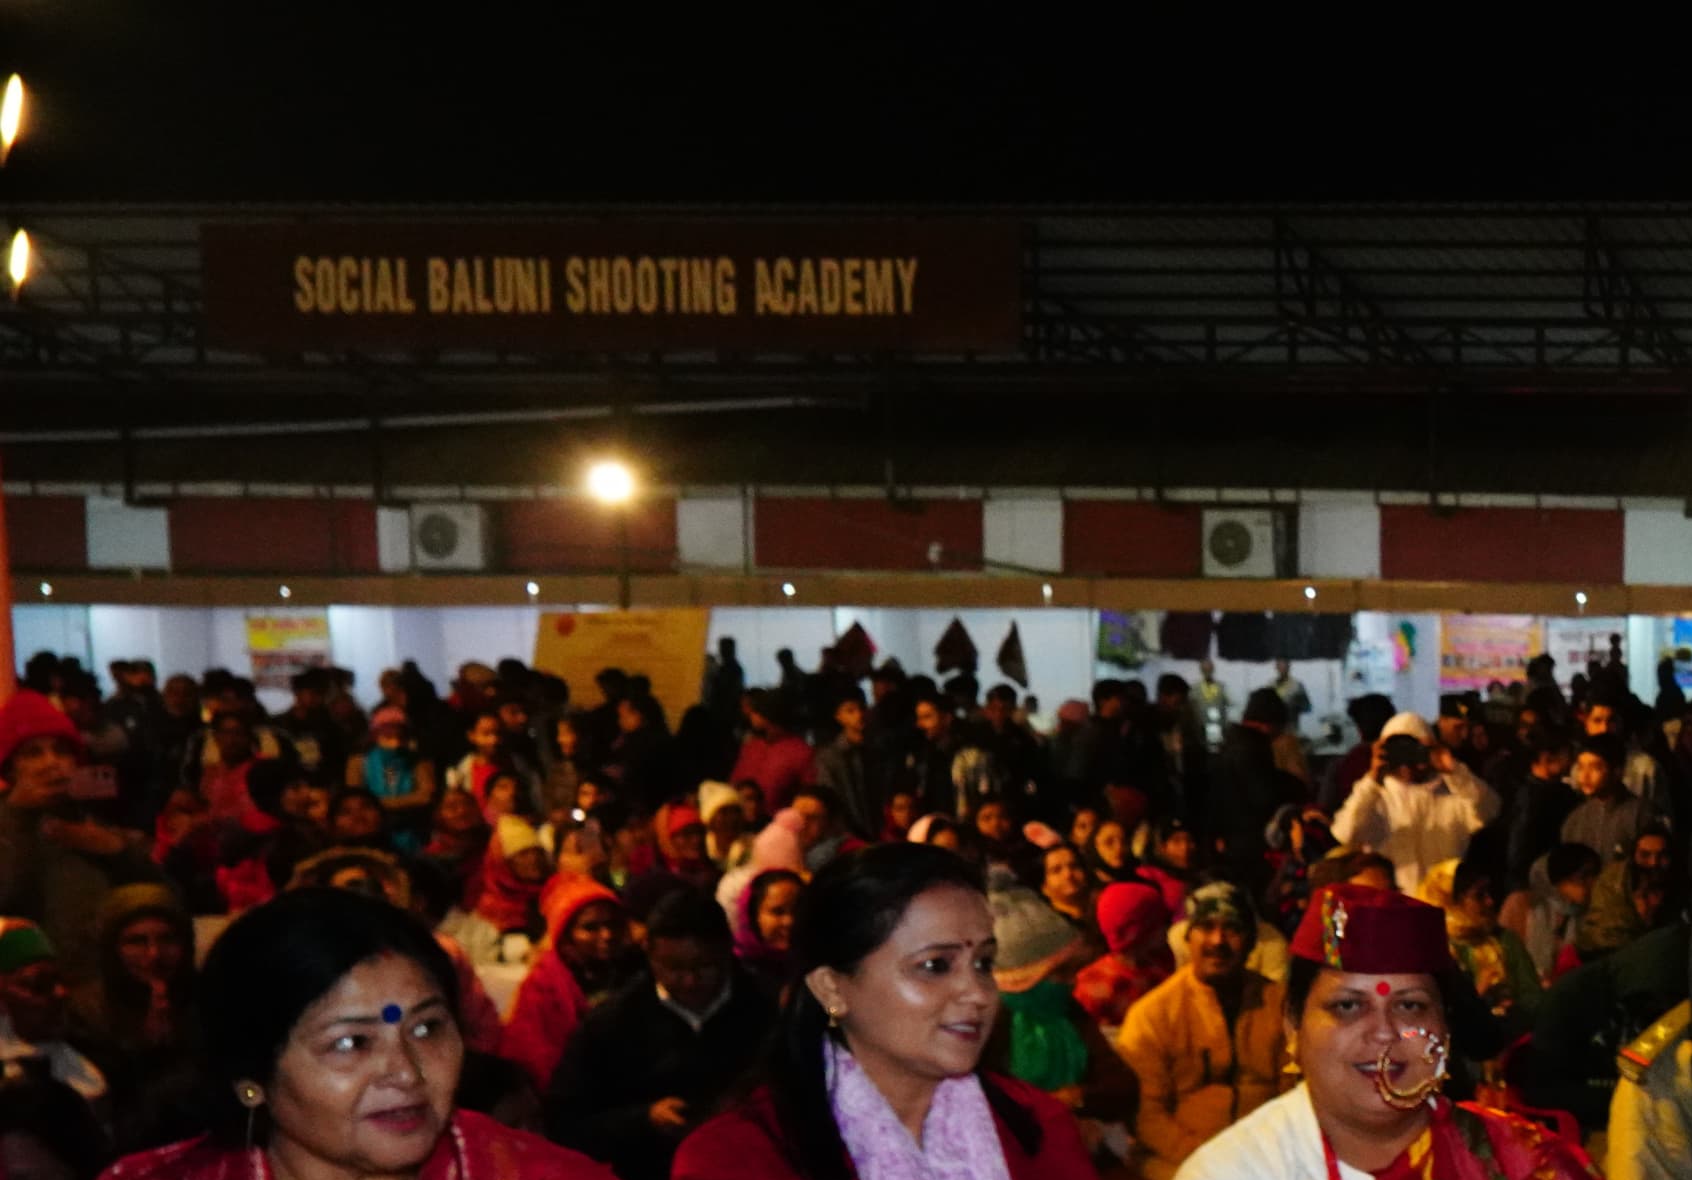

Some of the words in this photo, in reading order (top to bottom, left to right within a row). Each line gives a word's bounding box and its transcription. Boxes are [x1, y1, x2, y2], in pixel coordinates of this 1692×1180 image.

[294, 255, 415, 314] SOCIAL
[427, 256, 551, 314] BALUNI
[565, 256, 738, 315] SHOOTING
[755, 256, 918, 315] ACADEMY
